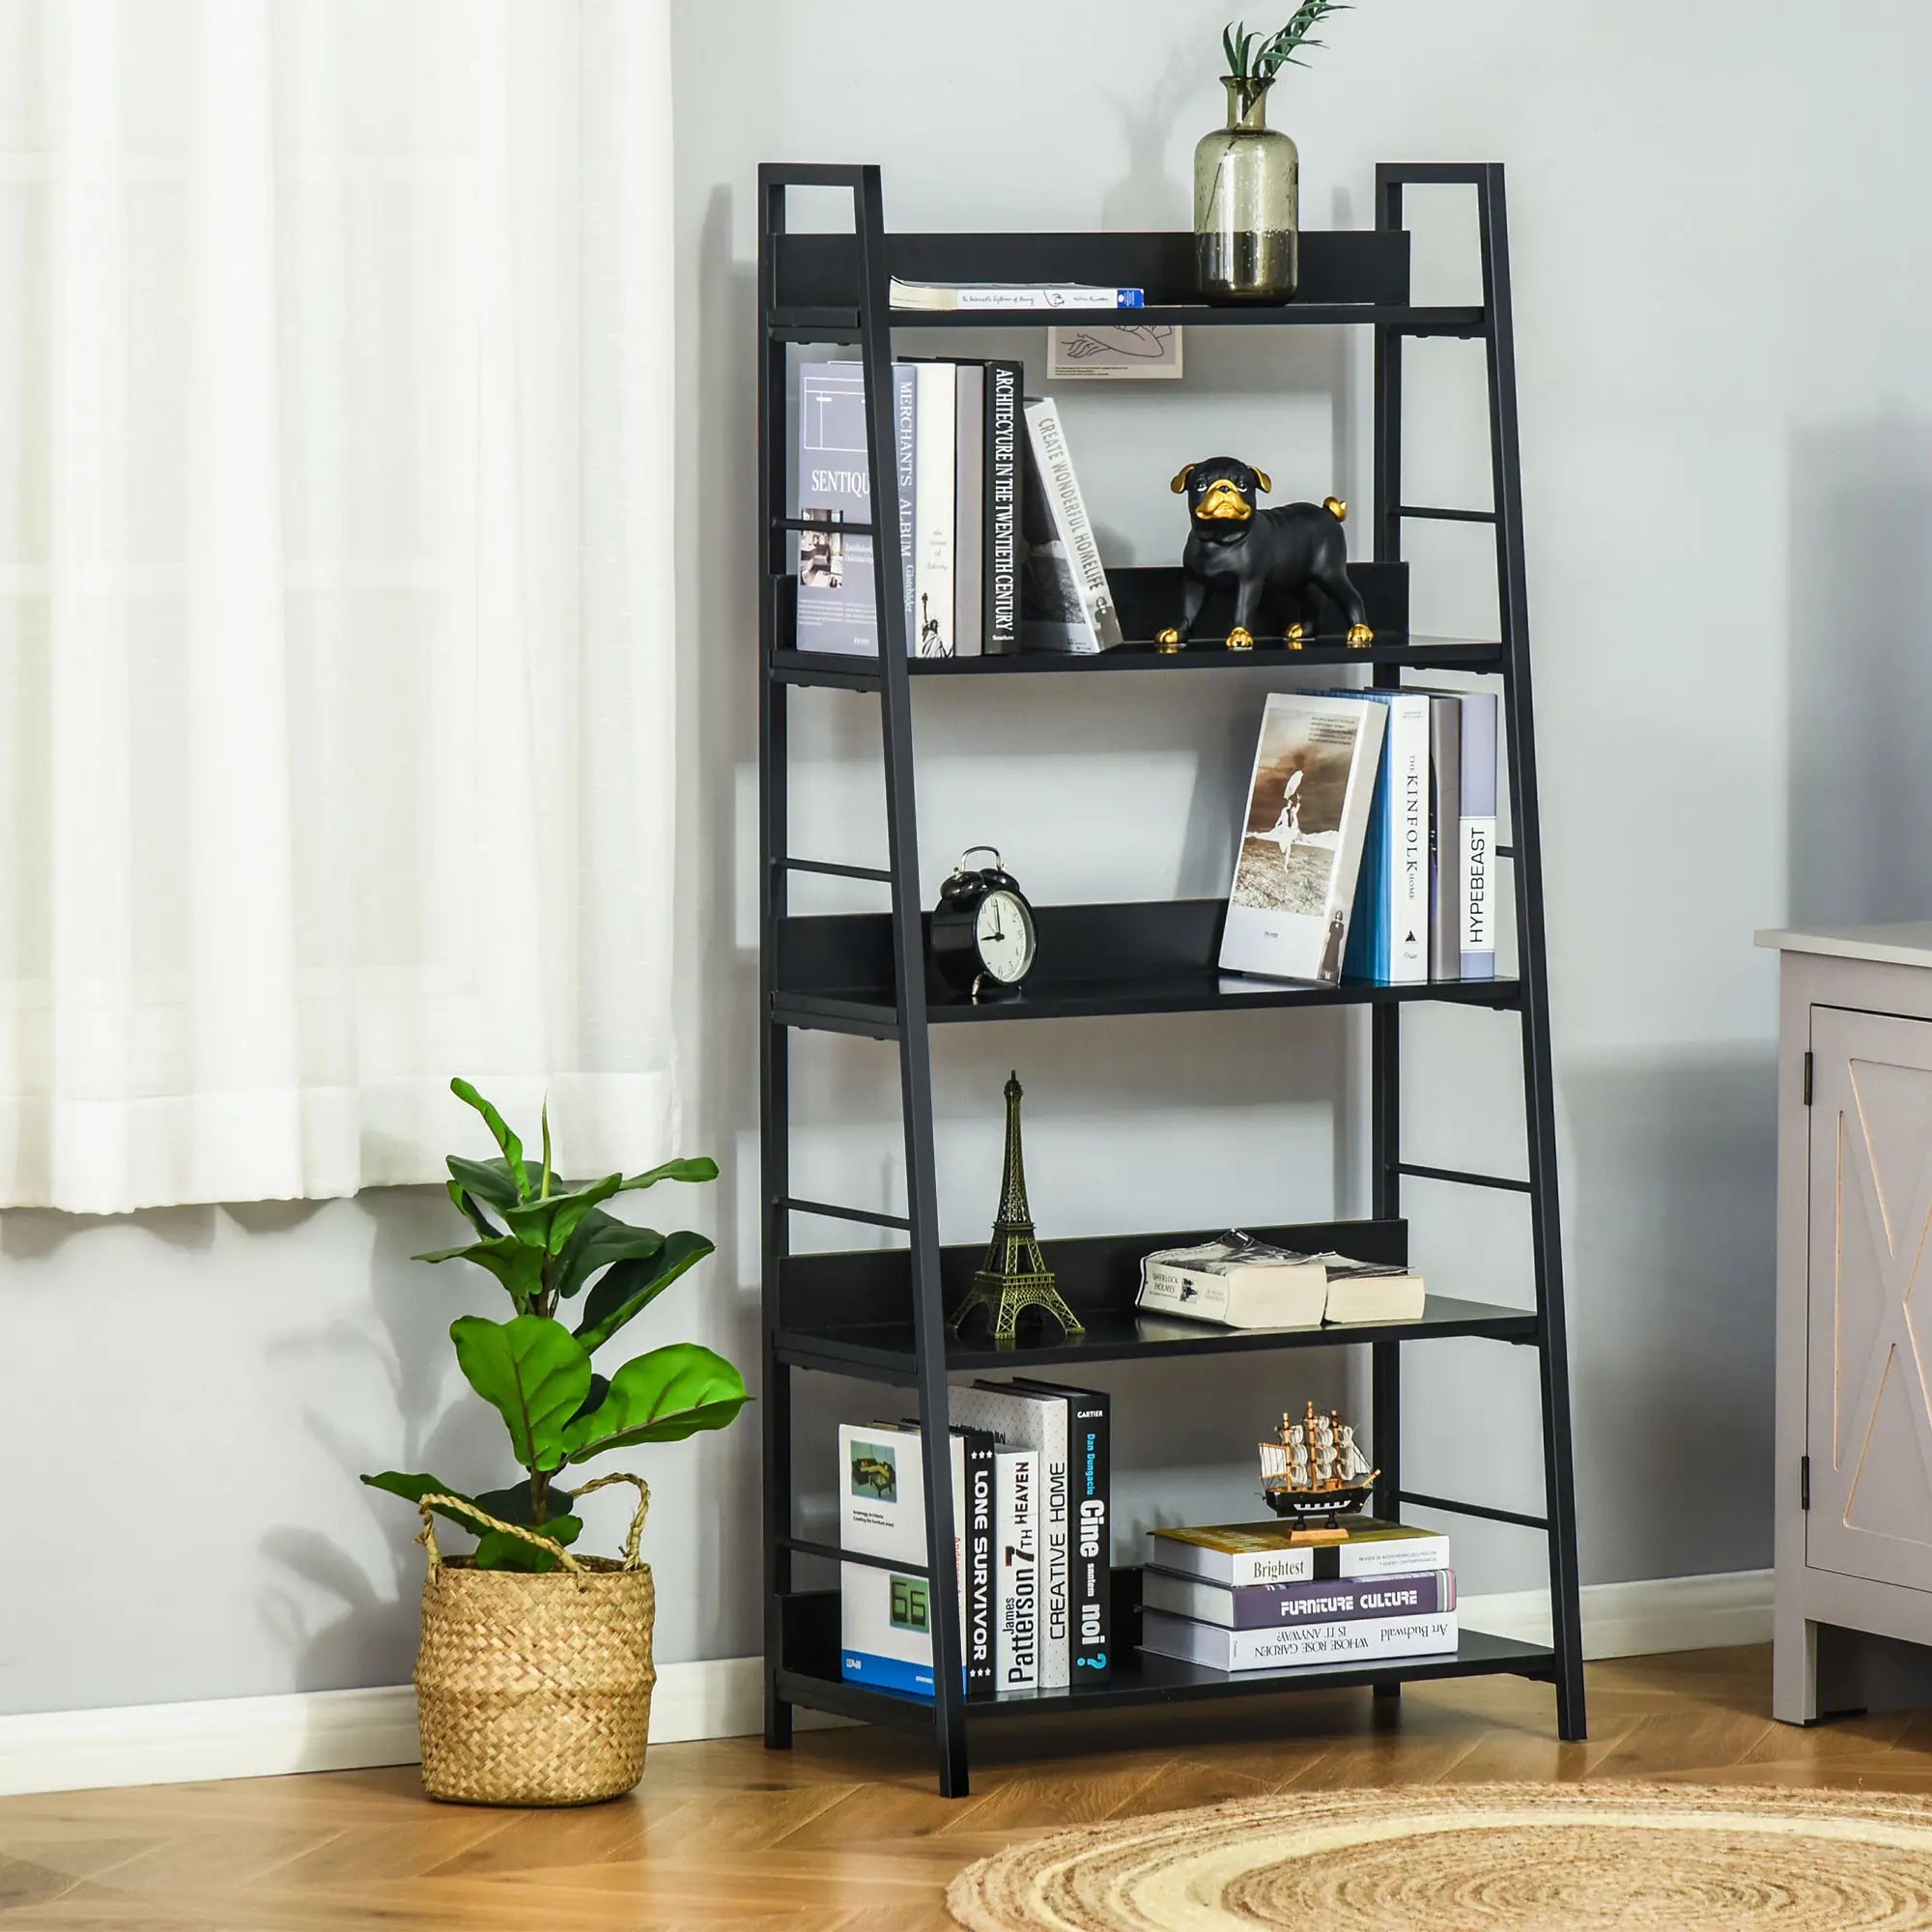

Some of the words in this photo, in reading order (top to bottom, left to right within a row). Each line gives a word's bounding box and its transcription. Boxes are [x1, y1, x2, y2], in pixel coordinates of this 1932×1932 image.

[899, 381, 913, 487] MERCHANTS
[1037, 417, 1065, 461] CREATE
[995, 463, 1014, 476] IN
[995, 477, 1014, 502] THE
[1050, 458, 1087, 533] WONDERFUL
[899, 497, 913, 557] ALBUM
[995, 503, 1014, 574] TWENTIETH
[1073, 532, 1105, 591] HOMELIFE
[995, 574, 1014, 631] CENTURY
[1406, 776, 1419, 872] KINFOLK
[1469, 827, 1486, 943] HYPEBEAST
[1077, 1409, 1103, 1419] CARTIER
[1086, 1434, 1096, 1451] Dan
[974, 1470, 989, 1530] LONE
[1014, 1462, 1030, 1525] HEAVEN
[1049, 1462, 1066, 1523] HOME
[1080, 1499, 1106, 1558] Cine
[1049, 1533, 1066, 1640] CREATIVE
[1253, 1559, 1305, 1581] Brightest
[973, 1536, 988, 1662] SURVIVOR
[1003, 1597, 1015, 1635] James
[1359, 1589, 1418, 1609] CULTURE
[1009, 1568, 1035, 1684] Patterson
[1081, 1604, 1106, 1645] noi
[1276, 1629, 1321, 1642] ANYWAY?
[1323, 1627, 1335, 1638] IT
[1330, 1637, 1369, 1651] WHOSE
[1338, 1626, 1347, 1637] IS
[1380, 1625, 1429, 1642] Buchwald
[1432, 1623, 1448, 1635] Art
[1254, 1644, 1299, 1658] GARDEN
[1302, 1640, 1327, 1654] ROSE
